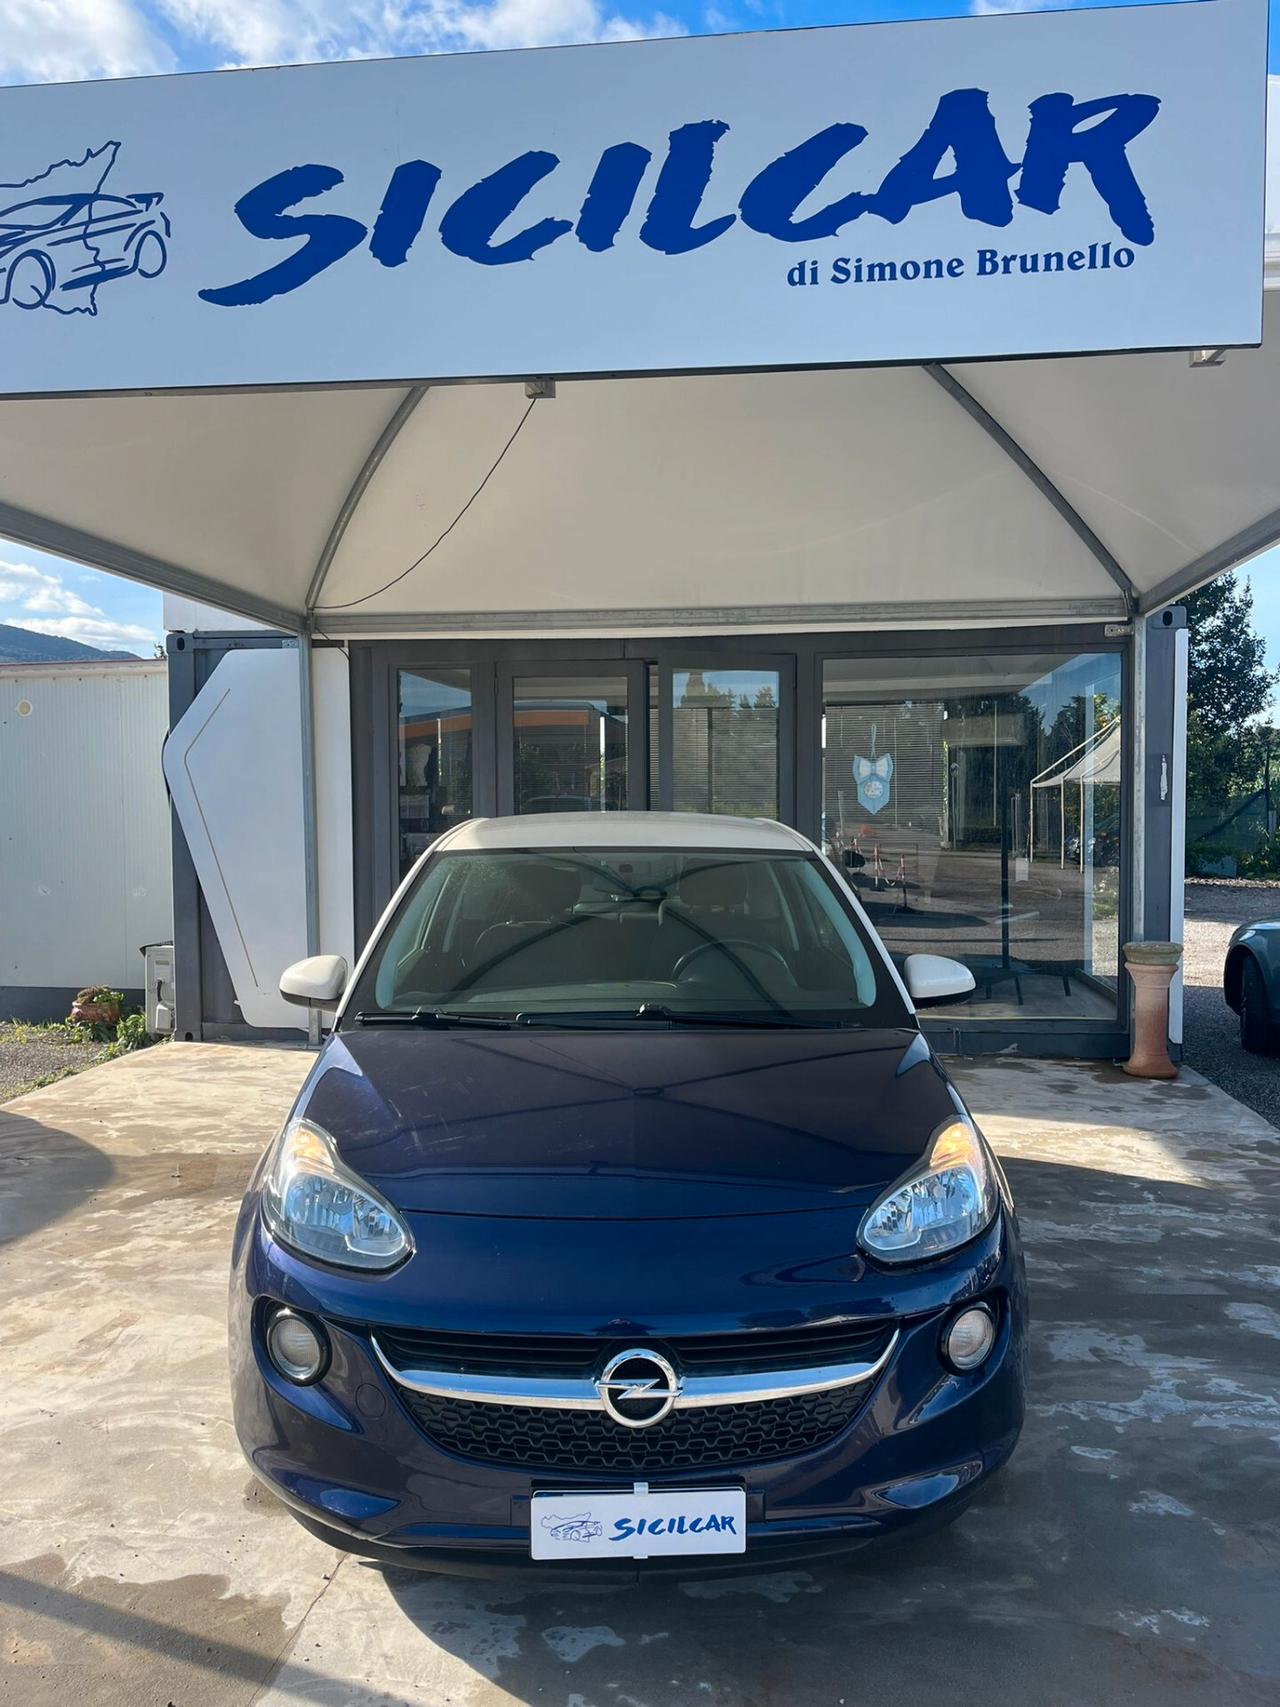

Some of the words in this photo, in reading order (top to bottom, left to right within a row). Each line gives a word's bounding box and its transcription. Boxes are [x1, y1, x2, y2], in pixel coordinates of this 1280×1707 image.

[197, 87, 1163, 308] SICILCAR
[786, 259, 820, 287] di
[829, 256, 965, 286] Simone
[975, 241, 1136, 277] Brunello
[608, 1513, 737, 1542] SICILCAR
